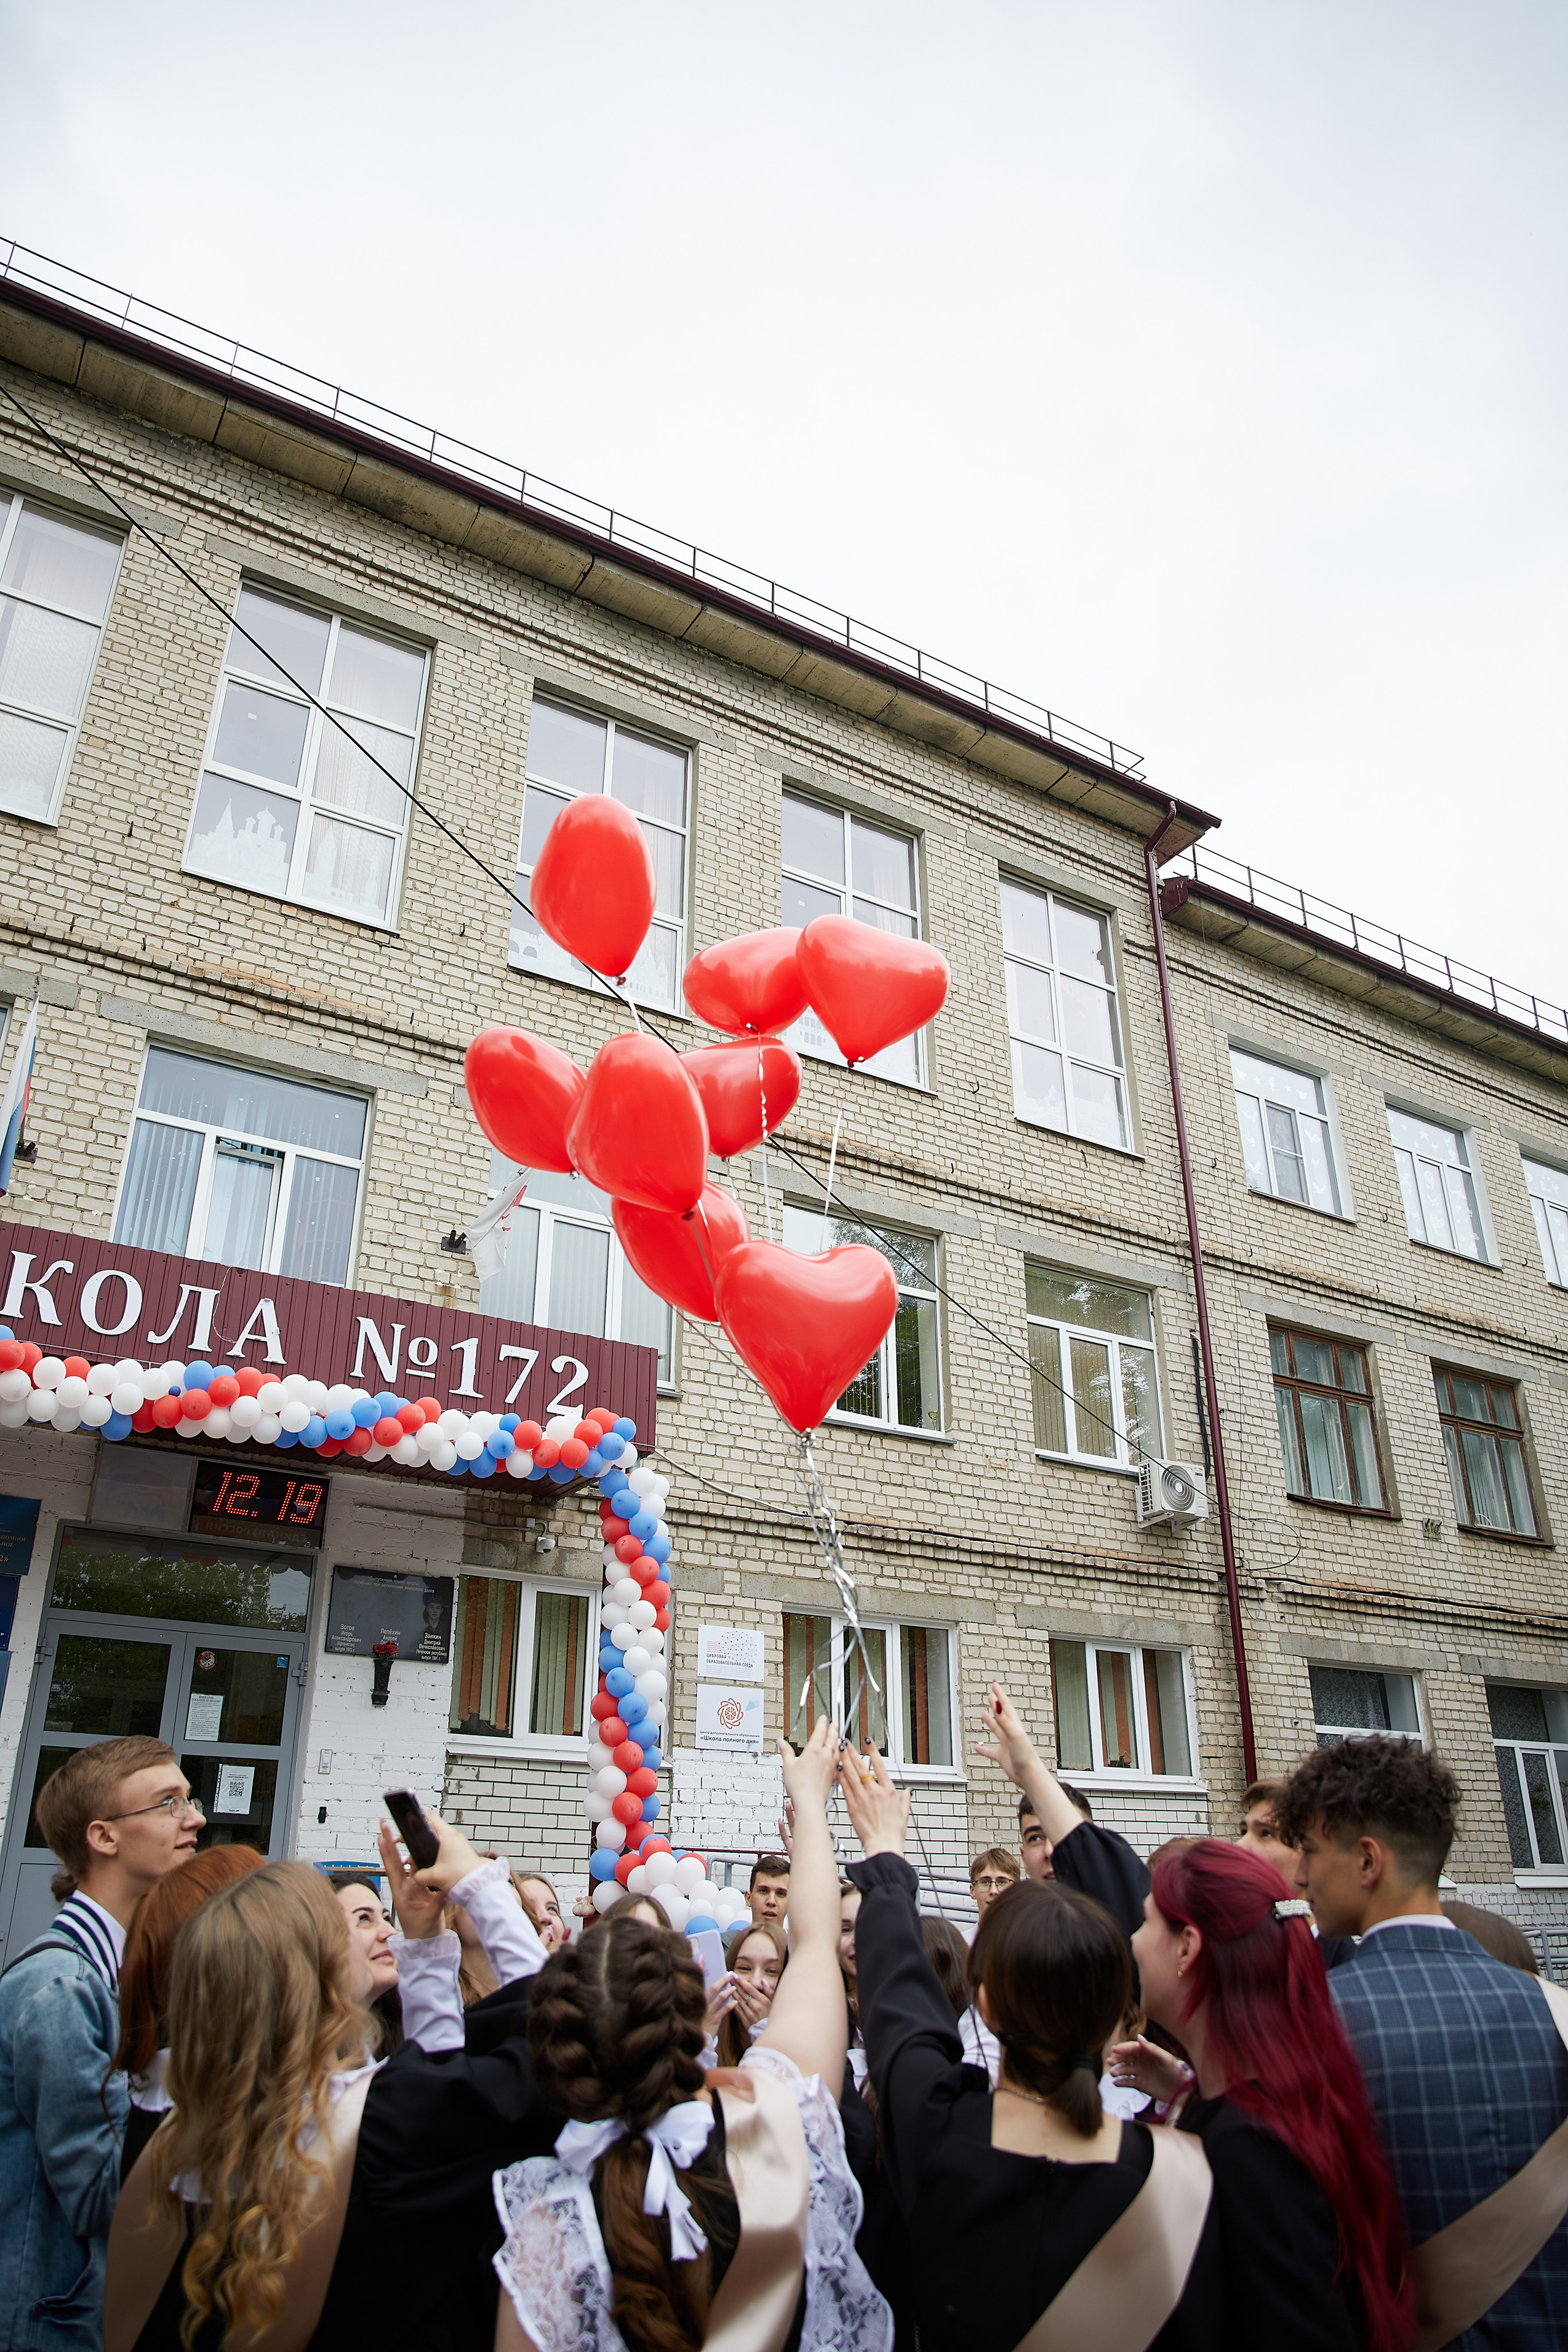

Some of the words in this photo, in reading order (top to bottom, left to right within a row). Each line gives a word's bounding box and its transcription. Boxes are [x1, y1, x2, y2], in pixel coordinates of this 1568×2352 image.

[0, 1250, 287, 1365] КОЛА
[350, 1316, 589, 1419] №172
[331, 1634, 361, 1643] Александрович
